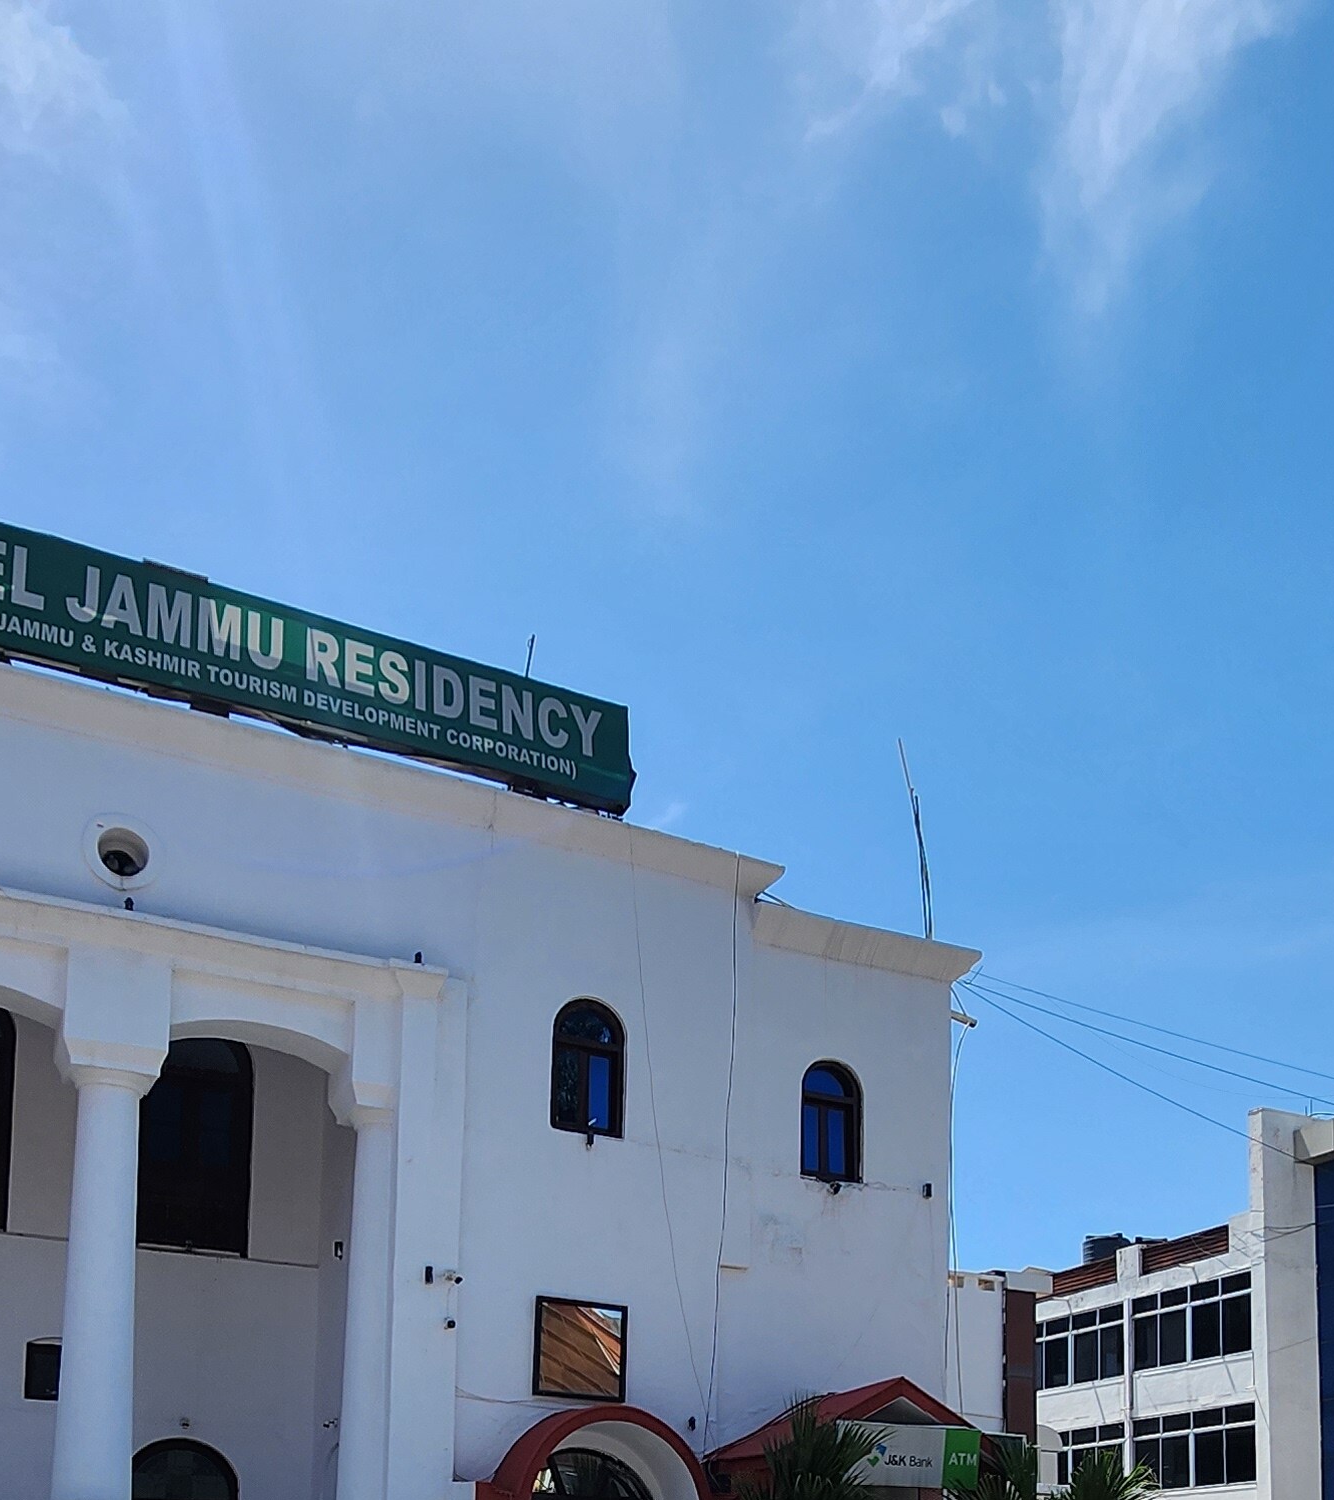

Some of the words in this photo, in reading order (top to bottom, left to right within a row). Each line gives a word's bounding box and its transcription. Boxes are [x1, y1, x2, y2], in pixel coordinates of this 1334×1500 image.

[65, 564, 284, 670] JAMMU
[306, 626, 603, 758] RESIDENCY
[81, 633, 97, 654] &
[104, 638, 201, 680] KASHMIR
[206, 663, 298, 704] TOURISM
[303, 690, 442, 740] DEVELOPMENT
[446, 728, 579, 781] CORPORATION)
[884, 1454, 907, 1466] J&K
[908, 1455, 933, 1468] Bank
[948, 1452, 978, 1466] ATM
